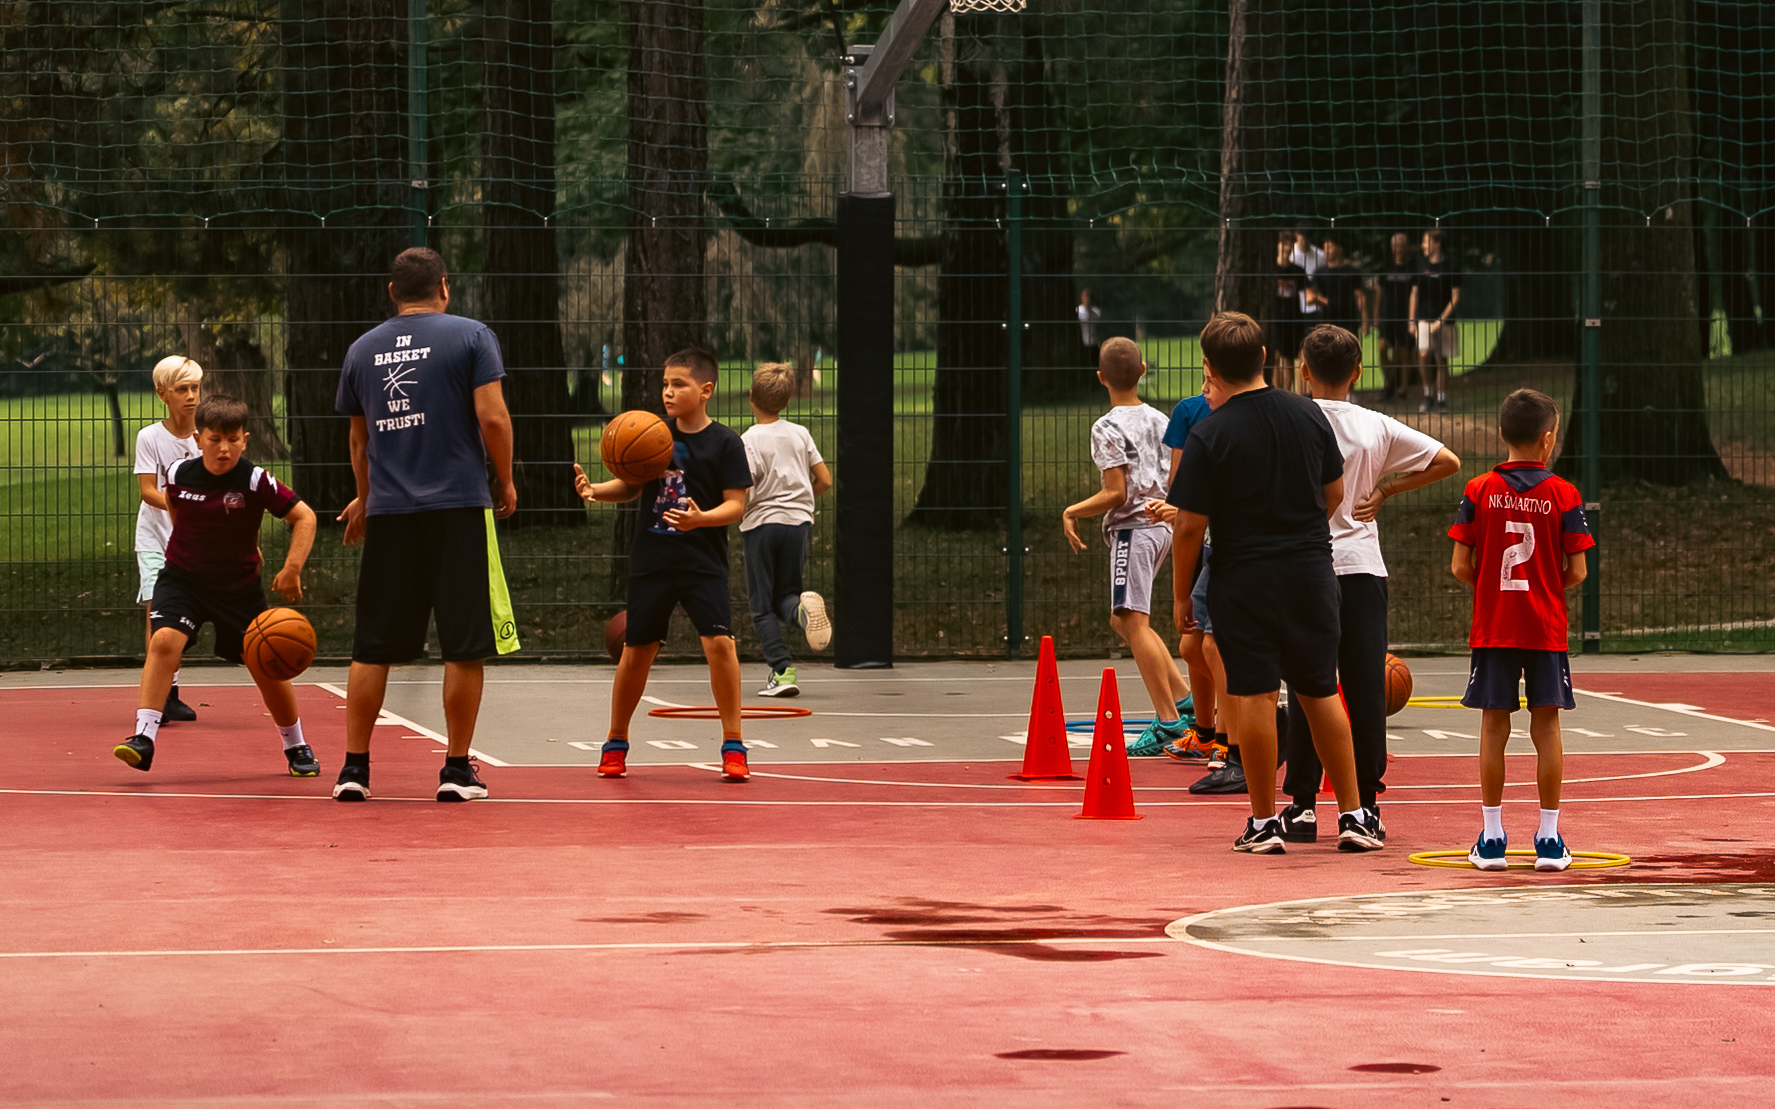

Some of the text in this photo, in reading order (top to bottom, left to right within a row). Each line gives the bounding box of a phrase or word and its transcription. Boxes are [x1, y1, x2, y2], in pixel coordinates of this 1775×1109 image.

[395, 335, 413, 348] IN
[374, 347, 431, 367] BASKET
[387, 398, 411, 413] WE
[376, 412, 425, 432] TRUST!
[178, 490, 207, 502] Zeus
[1488, 491, 1552, 515] NK ŠMARTNO
[1115, 541, 1129, 586] SPORT
[1499, 520, 1536, 592] 2
